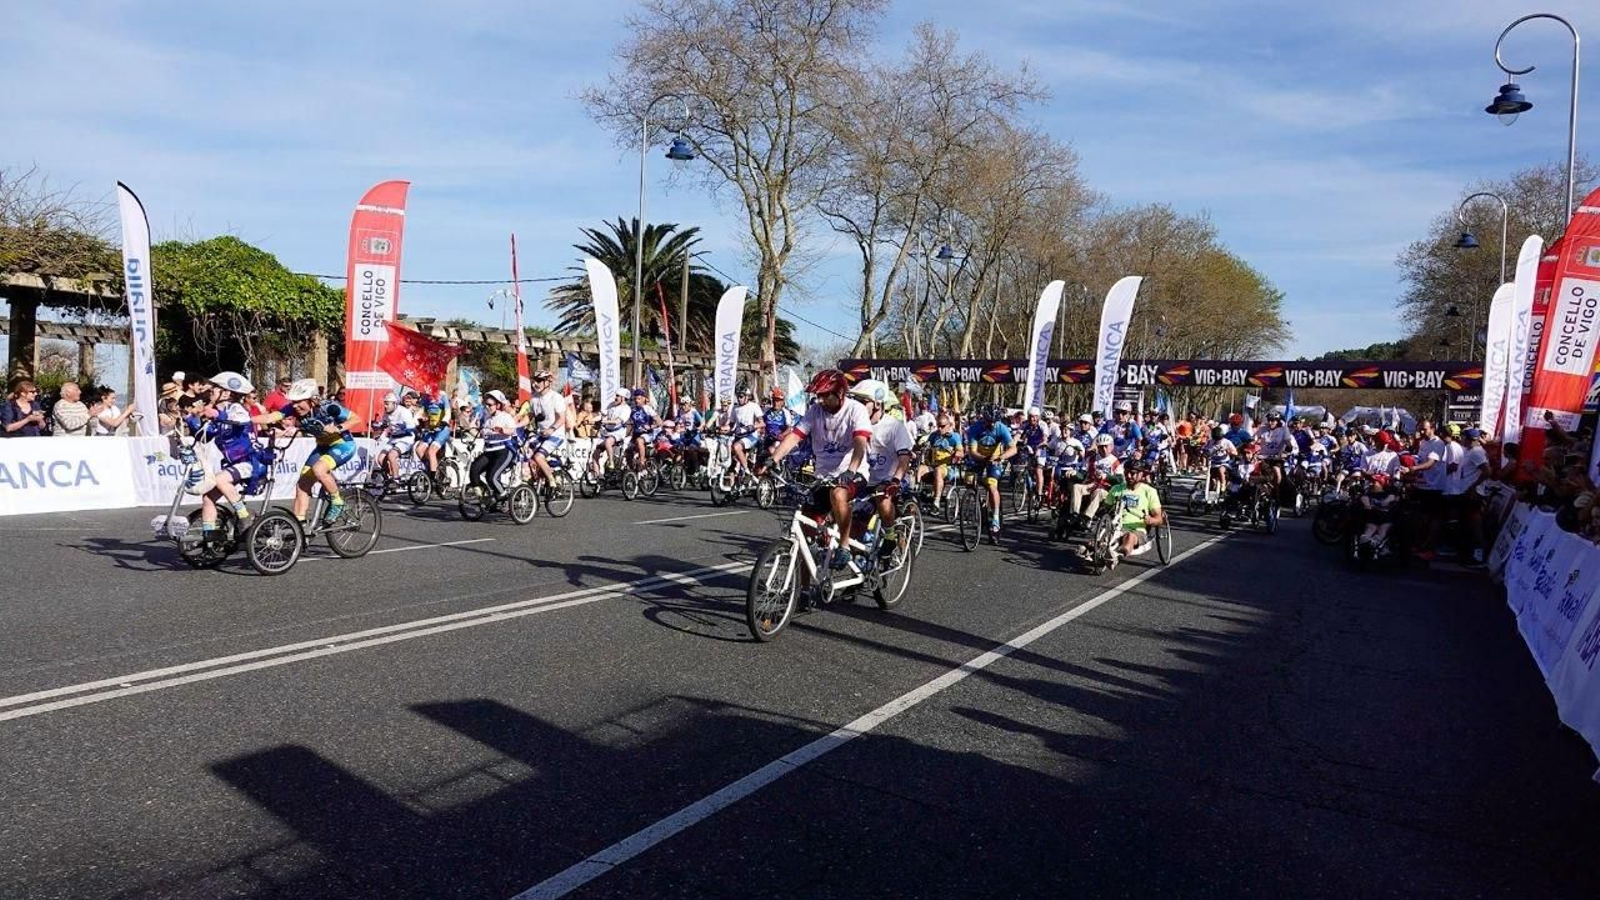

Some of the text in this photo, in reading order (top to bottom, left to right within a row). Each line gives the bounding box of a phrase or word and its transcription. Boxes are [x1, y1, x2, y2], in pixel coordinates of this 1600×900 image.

[361, 270, 373, 335] CONCELLO
[375, 278, 386, 308] VIGO
[1555, 286, 1584, 365] CONCELLO
[1100, 320, 1124, 398] ABANCA
[1571, 298, 1597, 358] DE VIGO
[719, 331, 736, 397] ABANCA
[1485, 339, 1505, 421] ABANCA
[0, 460, 99, 489] ANCA
[158, 463, 187, 481] aqu
